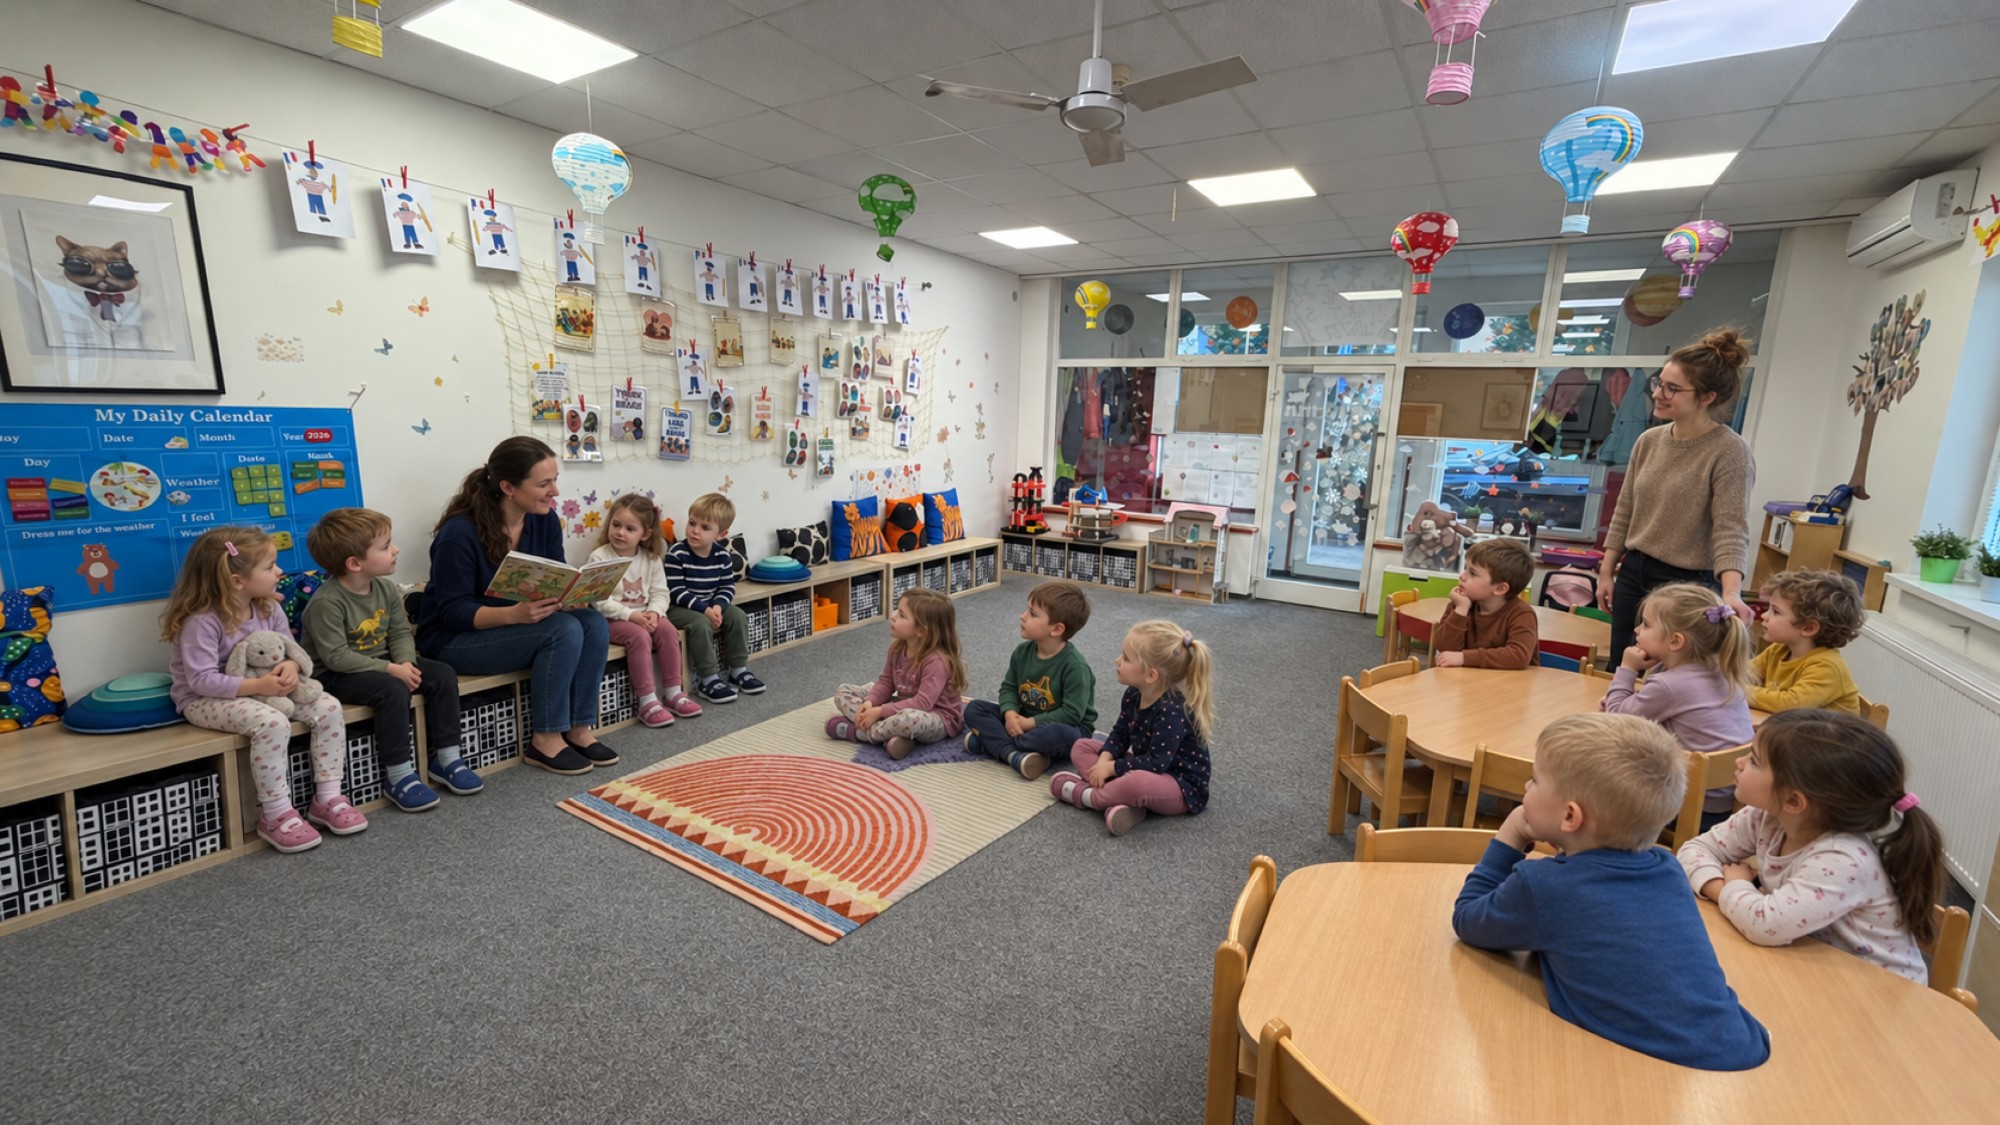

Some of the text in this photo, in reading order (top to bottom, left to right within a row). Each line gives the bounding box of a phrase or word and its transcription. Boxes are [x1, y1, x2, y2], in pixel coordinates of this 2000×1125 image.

[95, 408, 273, 425] My Daily Calendar
[103, 433, 135, 443] Date
[199, 433, 236, 442] Month
[283, 433, 305, 441] Year
[24, 458, 50, 468] Day
[165, 478, 220, 488] Weather
[181, 513, 188, 522] I
[22, 531, 56, 540] Dress
[57, 529, 75, 537] me
[77, 527, 93, 535] for
[114, 523, 155, 532] weather
